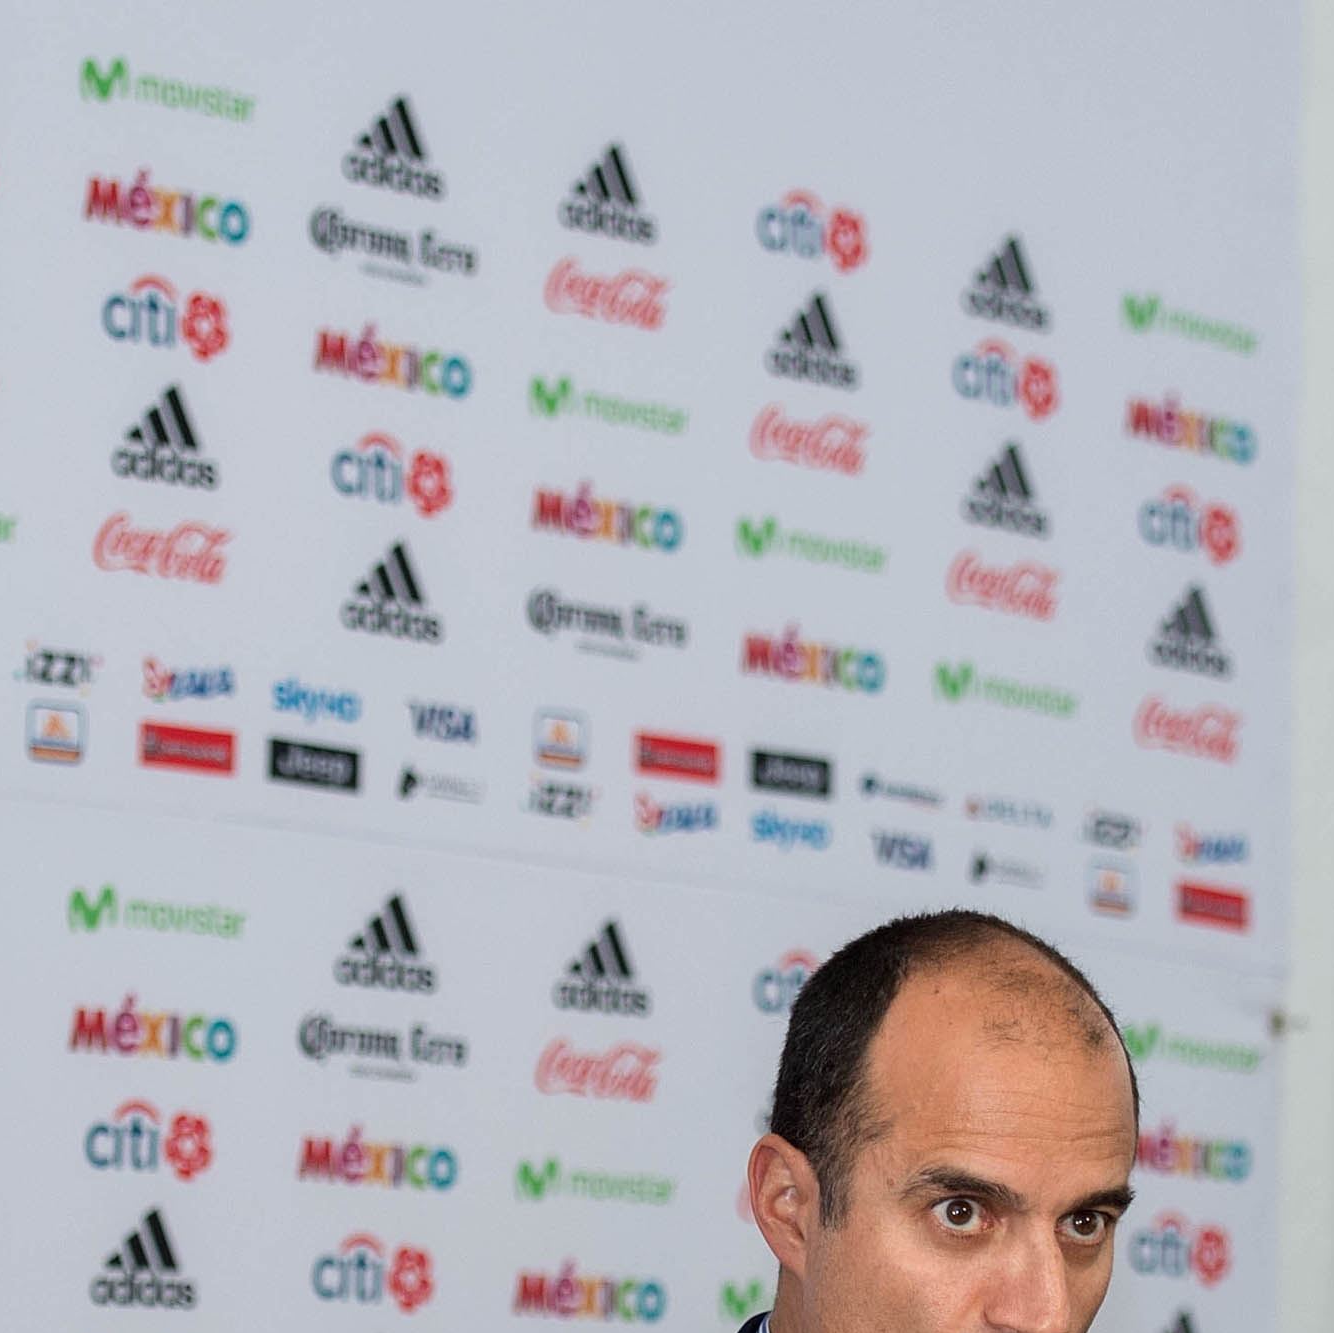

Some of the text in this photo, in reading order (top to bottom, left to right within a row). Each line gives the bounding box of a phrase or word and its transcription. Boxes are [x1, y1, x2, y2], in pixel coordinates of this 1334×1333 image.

[343, 154, 444, 197] adidas
[112, 445, 218, 488] adidas
[342, 599, 442, 642] adidas
[336, 951, 436, 992] adidas
[88, 1266, 197, 1309] adidas
